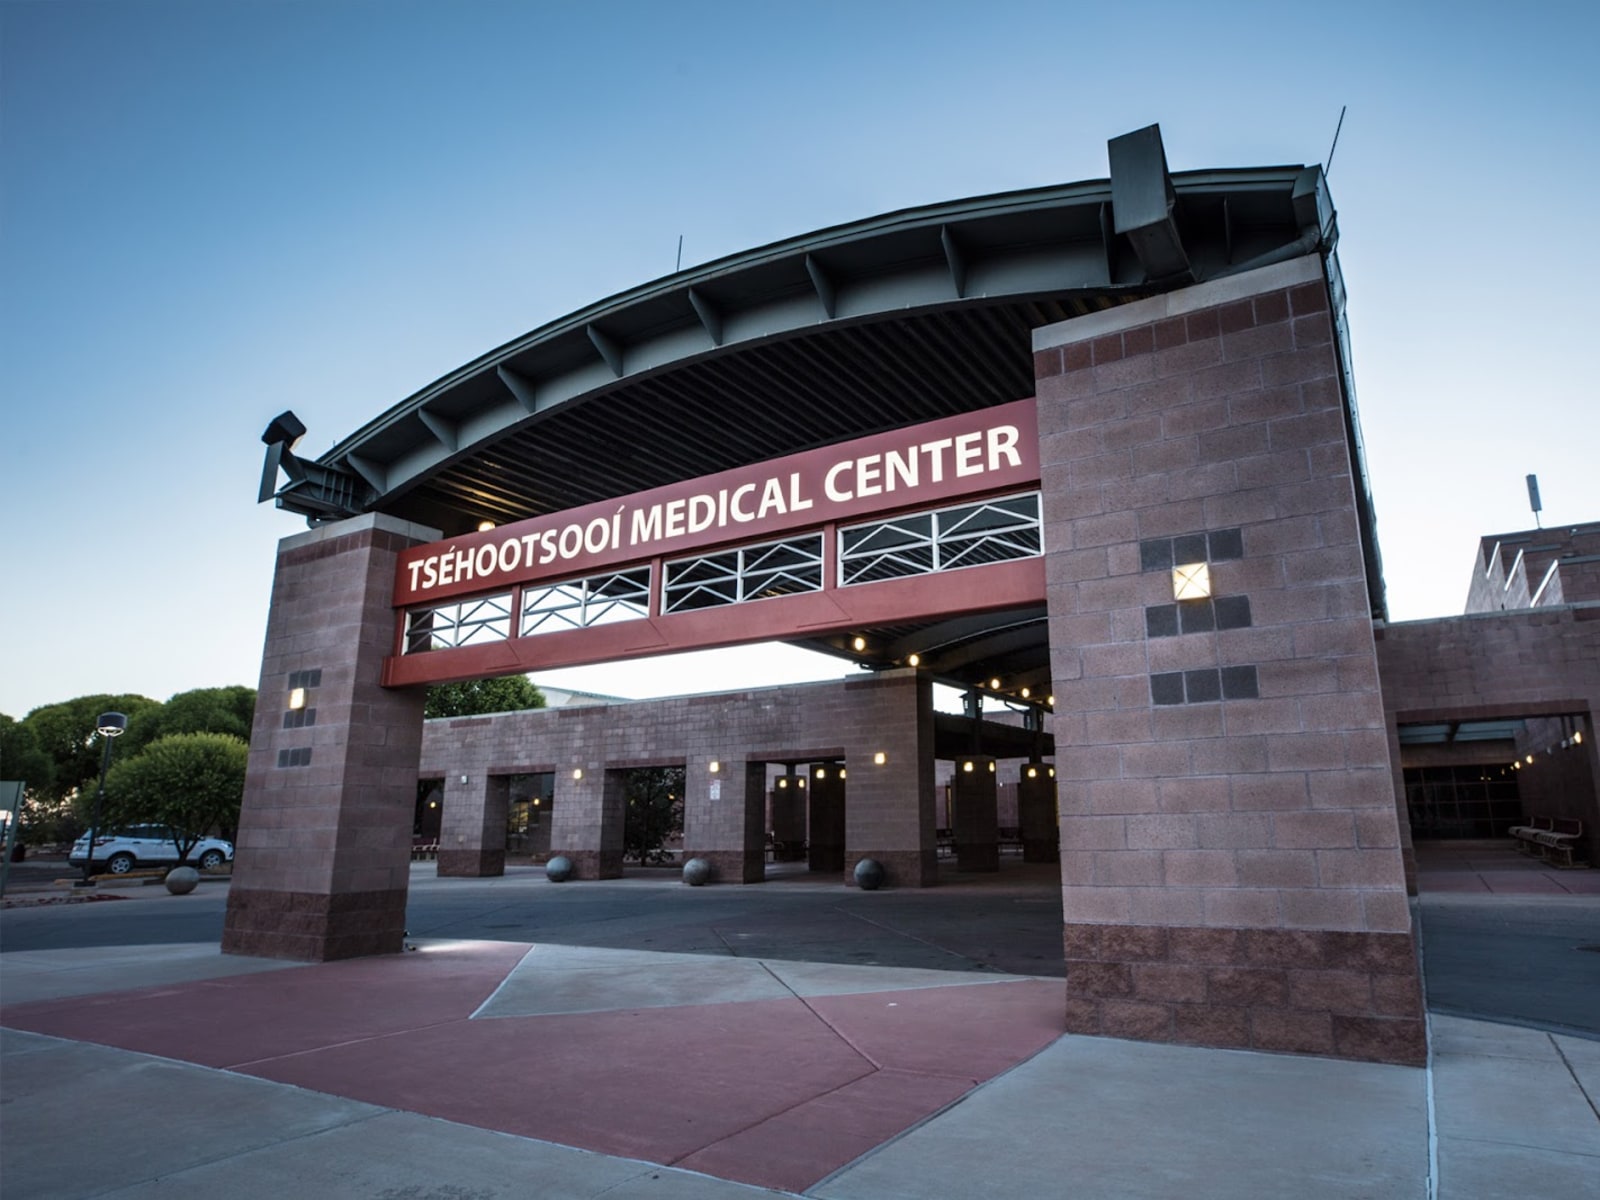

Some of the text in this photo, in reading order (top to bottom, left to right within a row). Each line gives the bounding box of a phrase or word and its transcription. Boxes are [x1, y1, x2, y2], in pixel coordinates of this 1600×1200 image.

[408, 424, 1023, 592] TSÉHOOTSOOÍ MEDICAL CENTER
